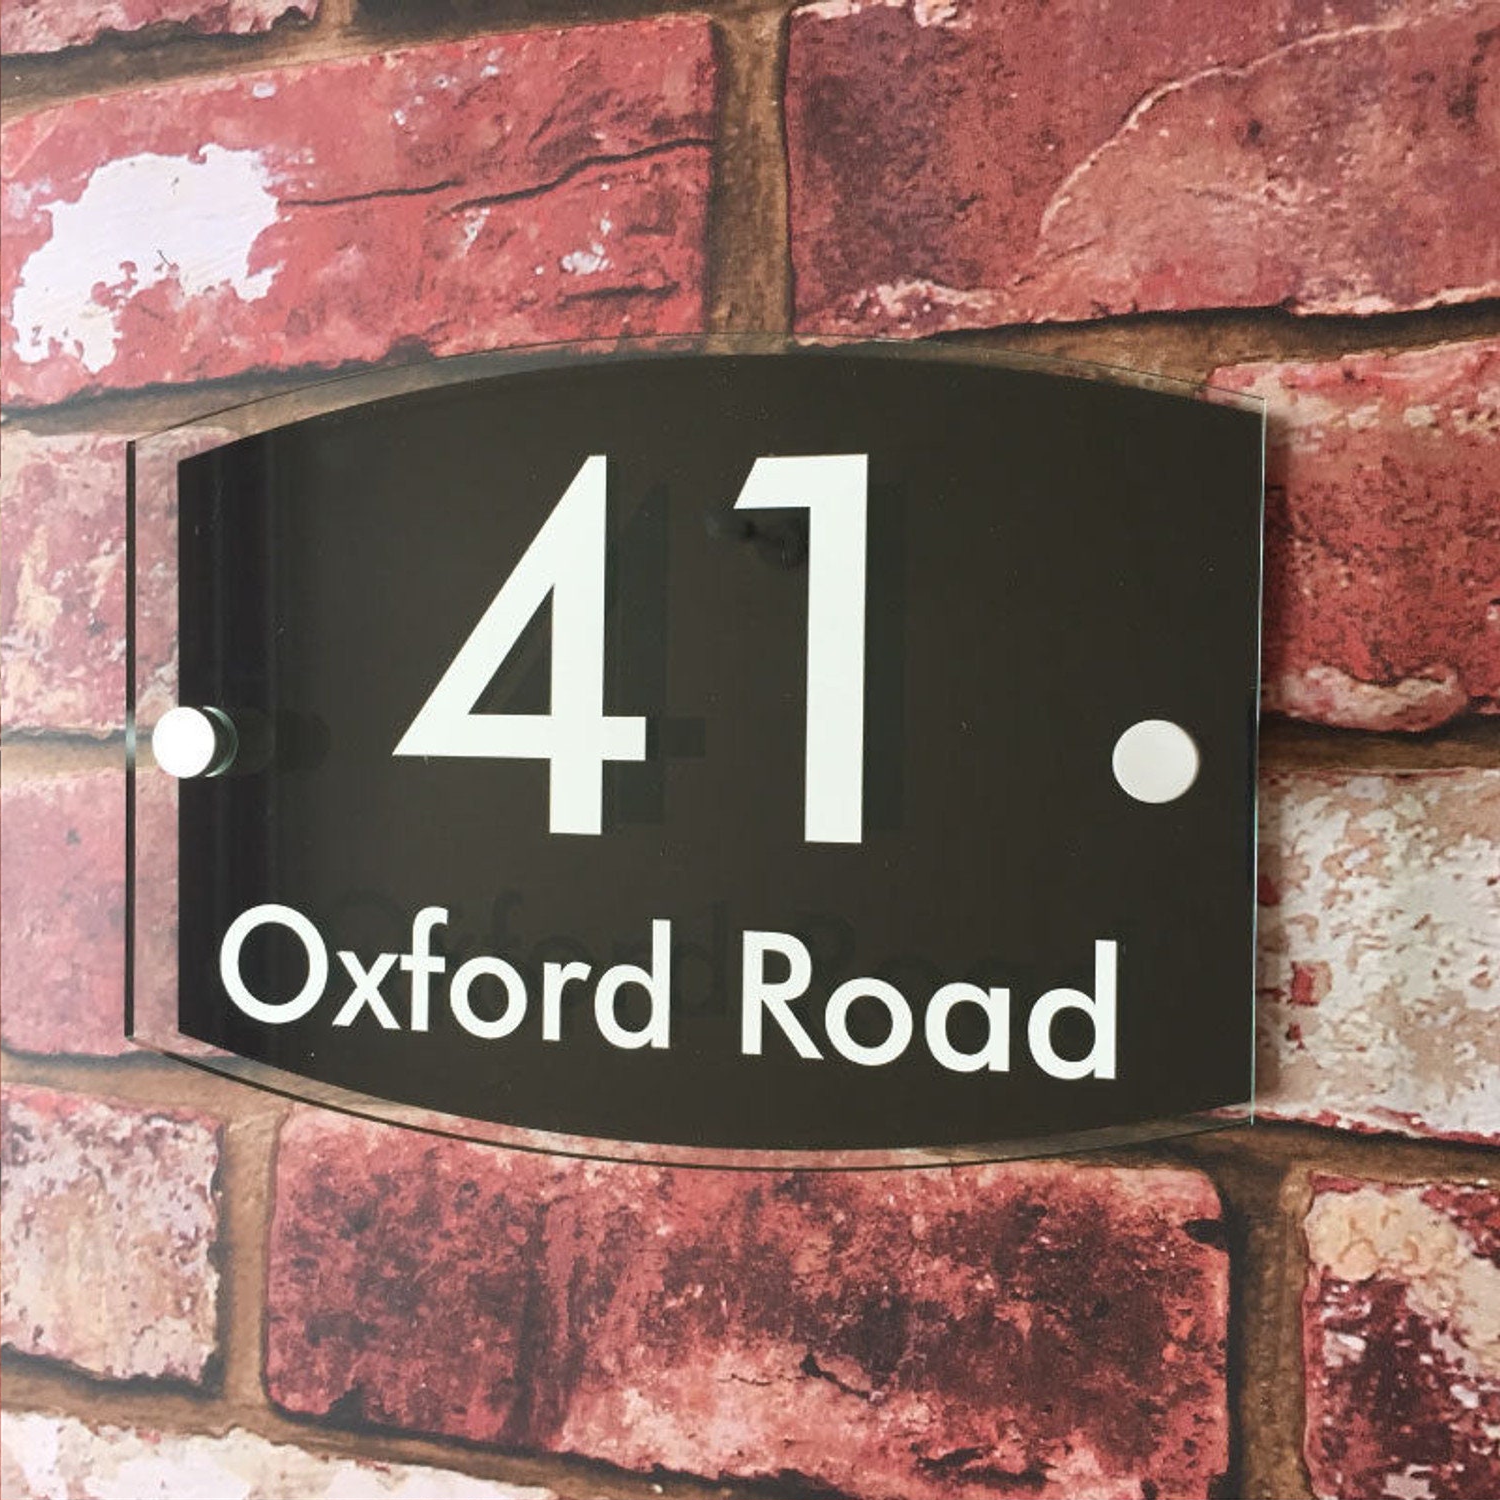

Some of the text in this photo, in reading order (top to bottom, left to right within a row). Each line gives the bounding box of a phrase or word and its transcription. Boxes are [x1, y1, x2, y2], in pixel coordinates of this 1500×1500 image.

[391, 453, 869, 843] 41
[220, 903, 1117, 1080] Oxford Road
